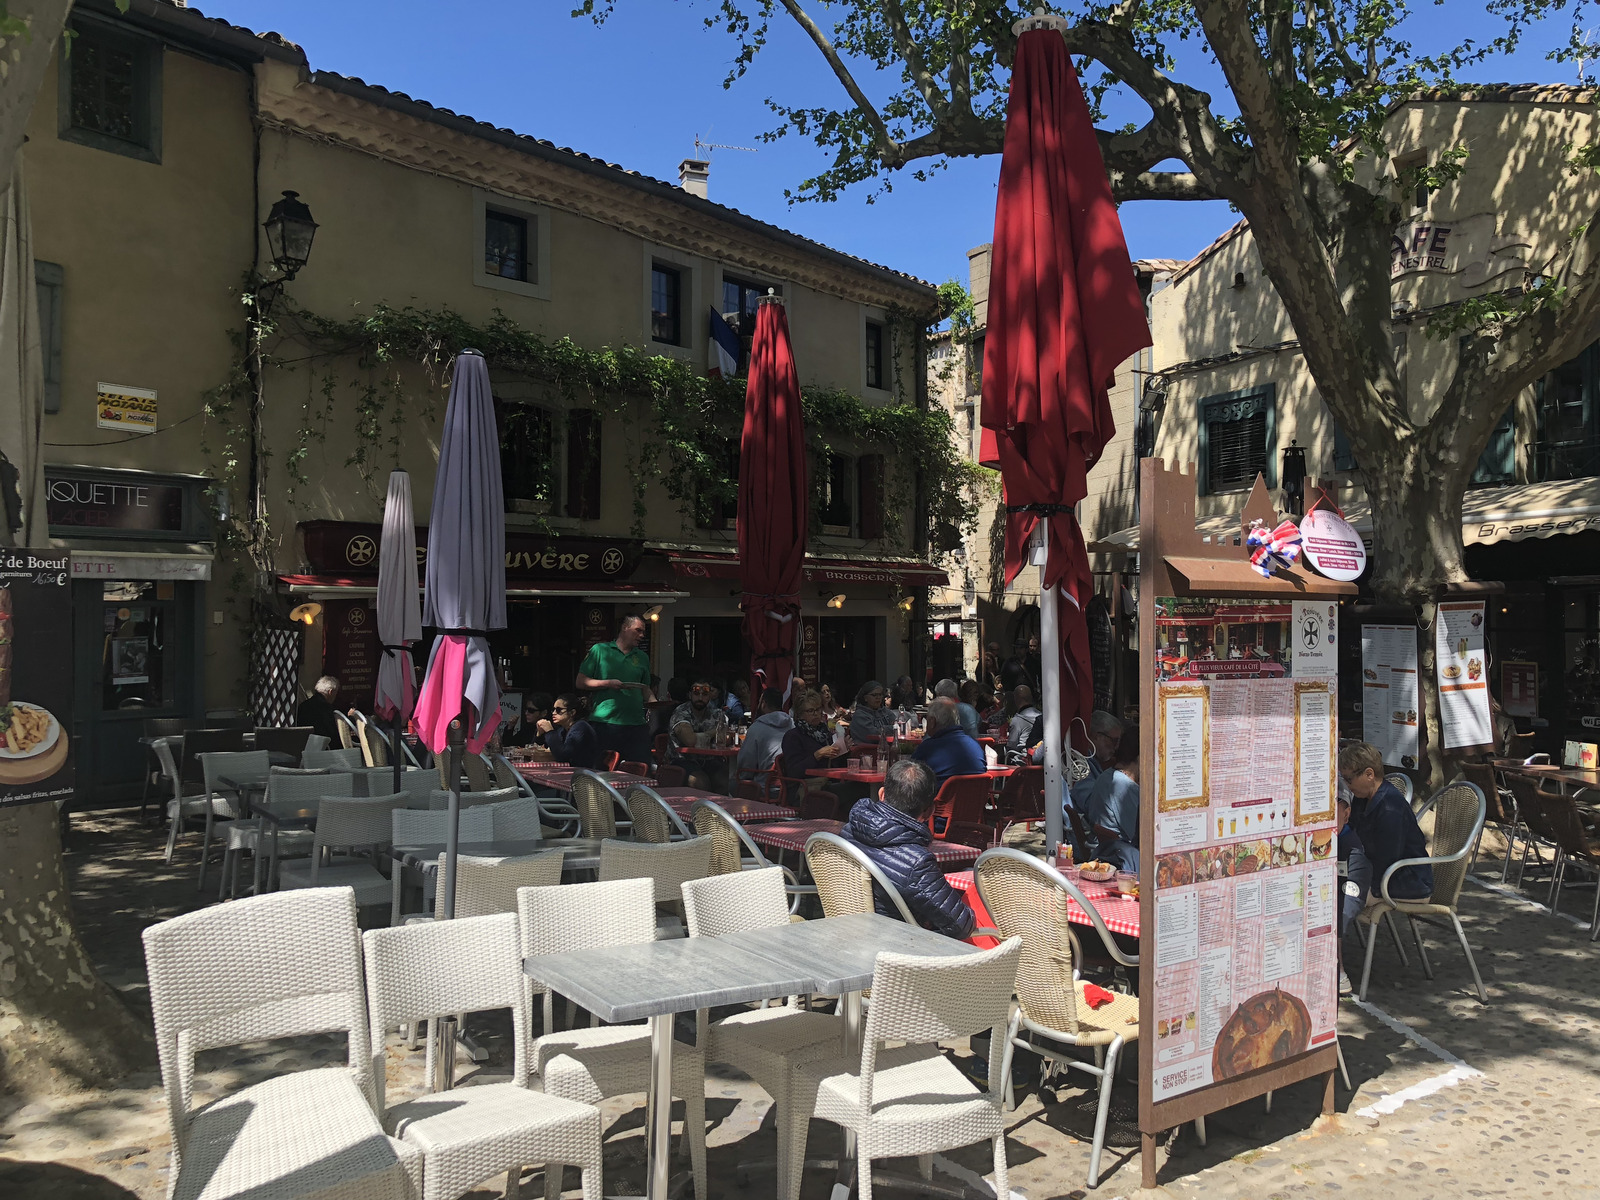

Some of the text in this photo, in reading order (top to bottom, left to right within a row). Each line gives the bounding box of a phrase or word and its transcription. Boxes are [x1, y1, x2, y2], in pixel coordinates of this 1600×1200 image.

[1478, 516, 1600, 538] Brasserie
[7, 556, 69, 569] de Boeuf
[57, 573, 67, 586] €
[825, 570, 898, 583] BRASSERIE
[1162, 1069, 1188, 1083] SERVICE
[1162, 1076, 1188, 1090] NON STOP
